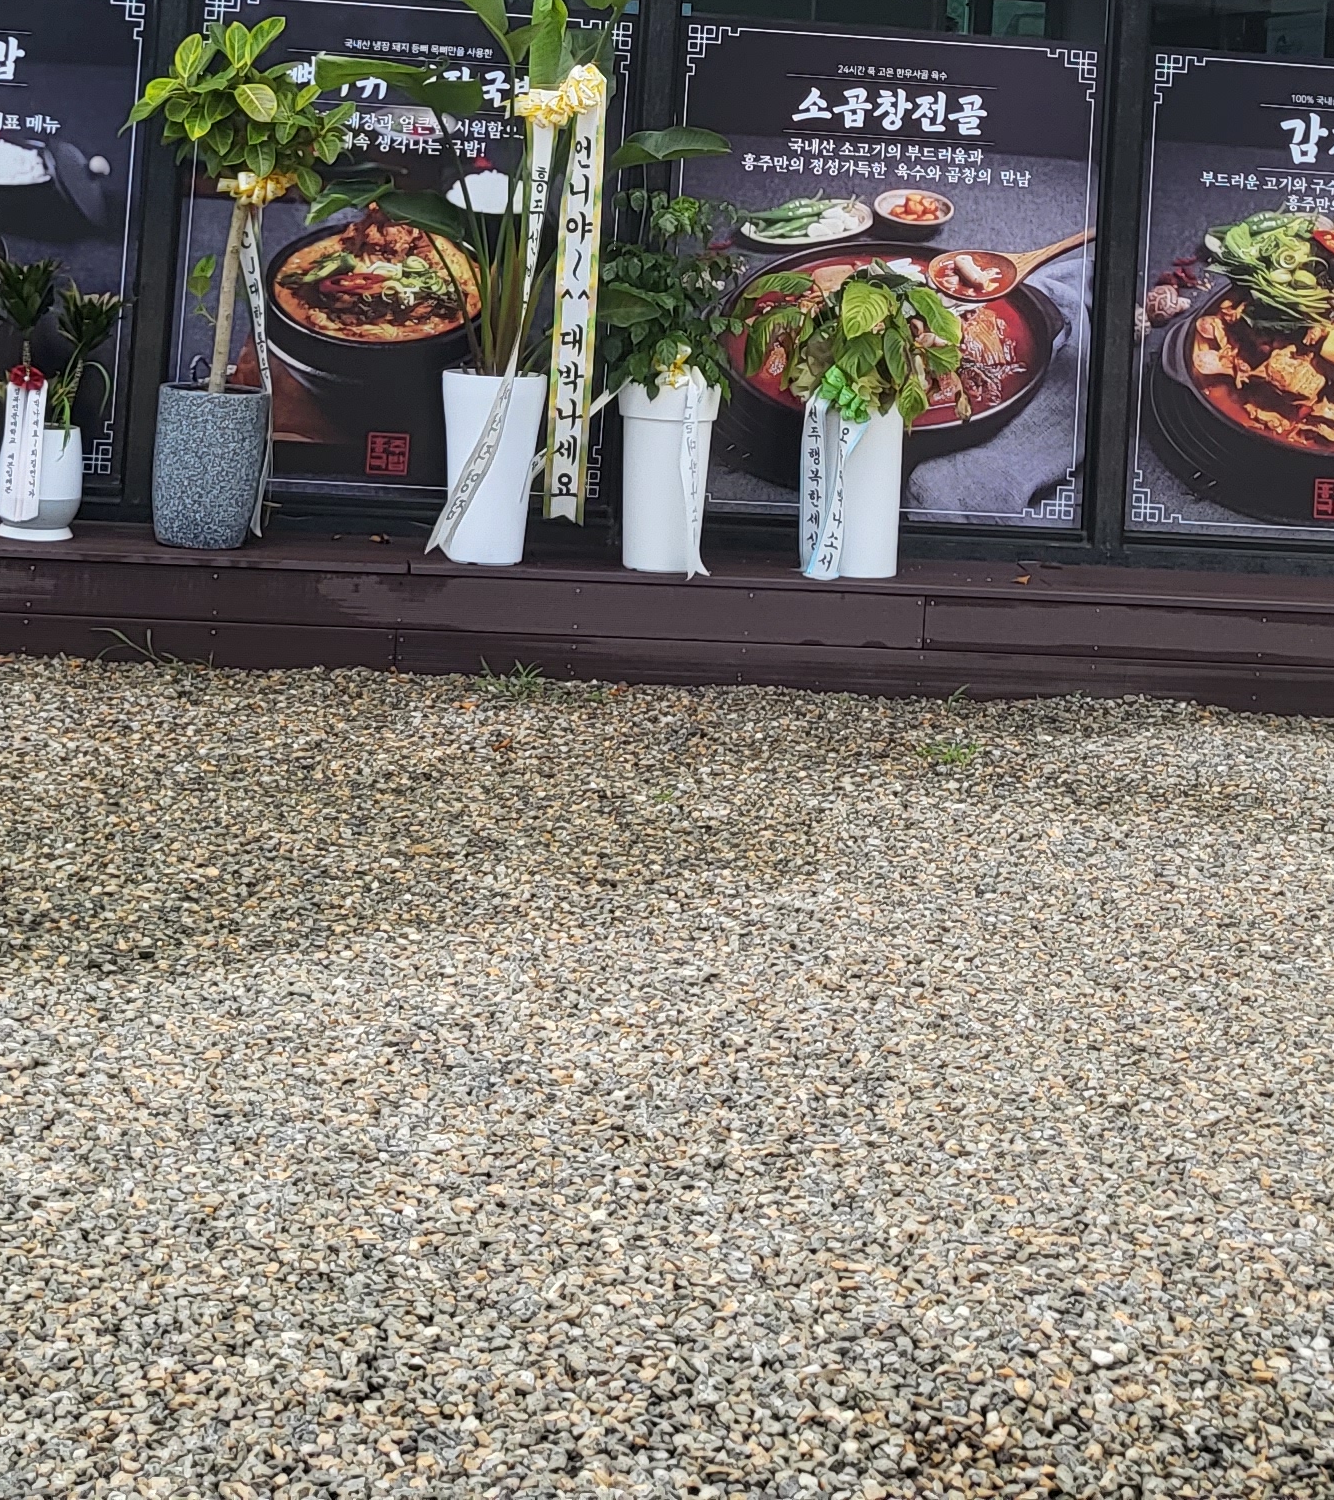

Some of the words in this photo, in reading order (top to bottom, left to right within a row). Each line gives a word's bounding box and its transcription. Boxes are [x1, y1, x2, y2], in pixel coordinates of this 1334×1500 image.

[344, 38, 370, 50] 국내산
[467, 47, 493, 59] 사용한
[837, 64, 865, 75] 24시간
[791, 86, 989, 136] 소곱창전골
[1291, 94, 1315, 105] 100%
[26, 114, 62, 136] 메뉴
[374, 134, 442, 156] 생각나는
[787, 137, 835, 156] 국내산
[838, 141, 902, 161] 소고기의
[905, 145, 984, 166] 부드러움과
[741, 152, 805, 174] 흥주만의
[808, 157, 887, 180] 정성가득한
[894, 162, 942, 183] 육수와
[945, 166, 992, 186] 곱창의
[1000, 170, 1032, 188] 만남
[1199, 170, 1260, 191] 부드러운
[1262, 175, 1308, 195] 고기와
[550, 323, 585, 498] 대박나세요
